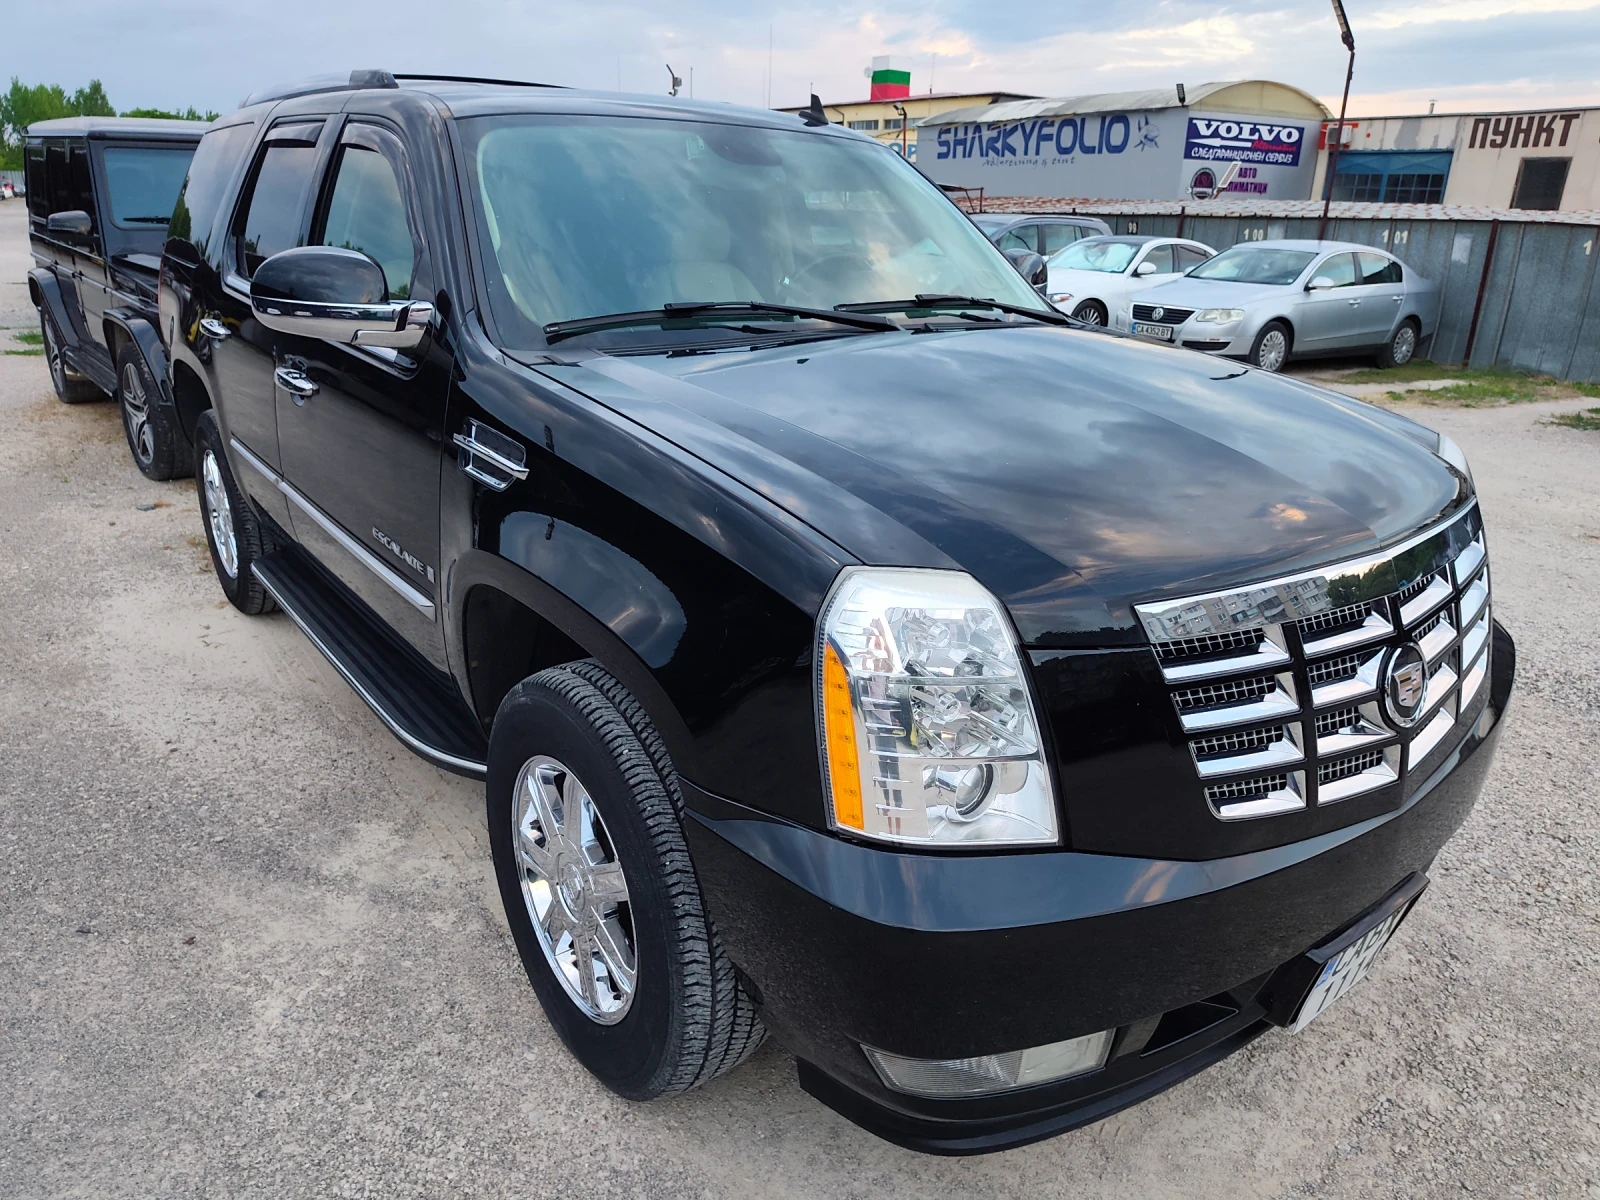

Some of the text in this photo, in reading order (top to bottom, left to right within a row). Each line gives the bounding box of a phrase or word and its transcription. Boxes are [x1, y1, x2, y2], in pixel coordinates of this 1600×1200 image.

[937, 114, 1130, 159] SHARKYFOLIO
[1193, 119, 1299, 143] VOLVO
[1468, 113, 1580, 149] ПУНКТ
[1265, 152, 1293, 164] СЕРВИЗ
[1238, 167, 1258, 179] АВТО
[1128, 222, 1137, 233] 99
[1145, 326, 1160, 336] 4352
